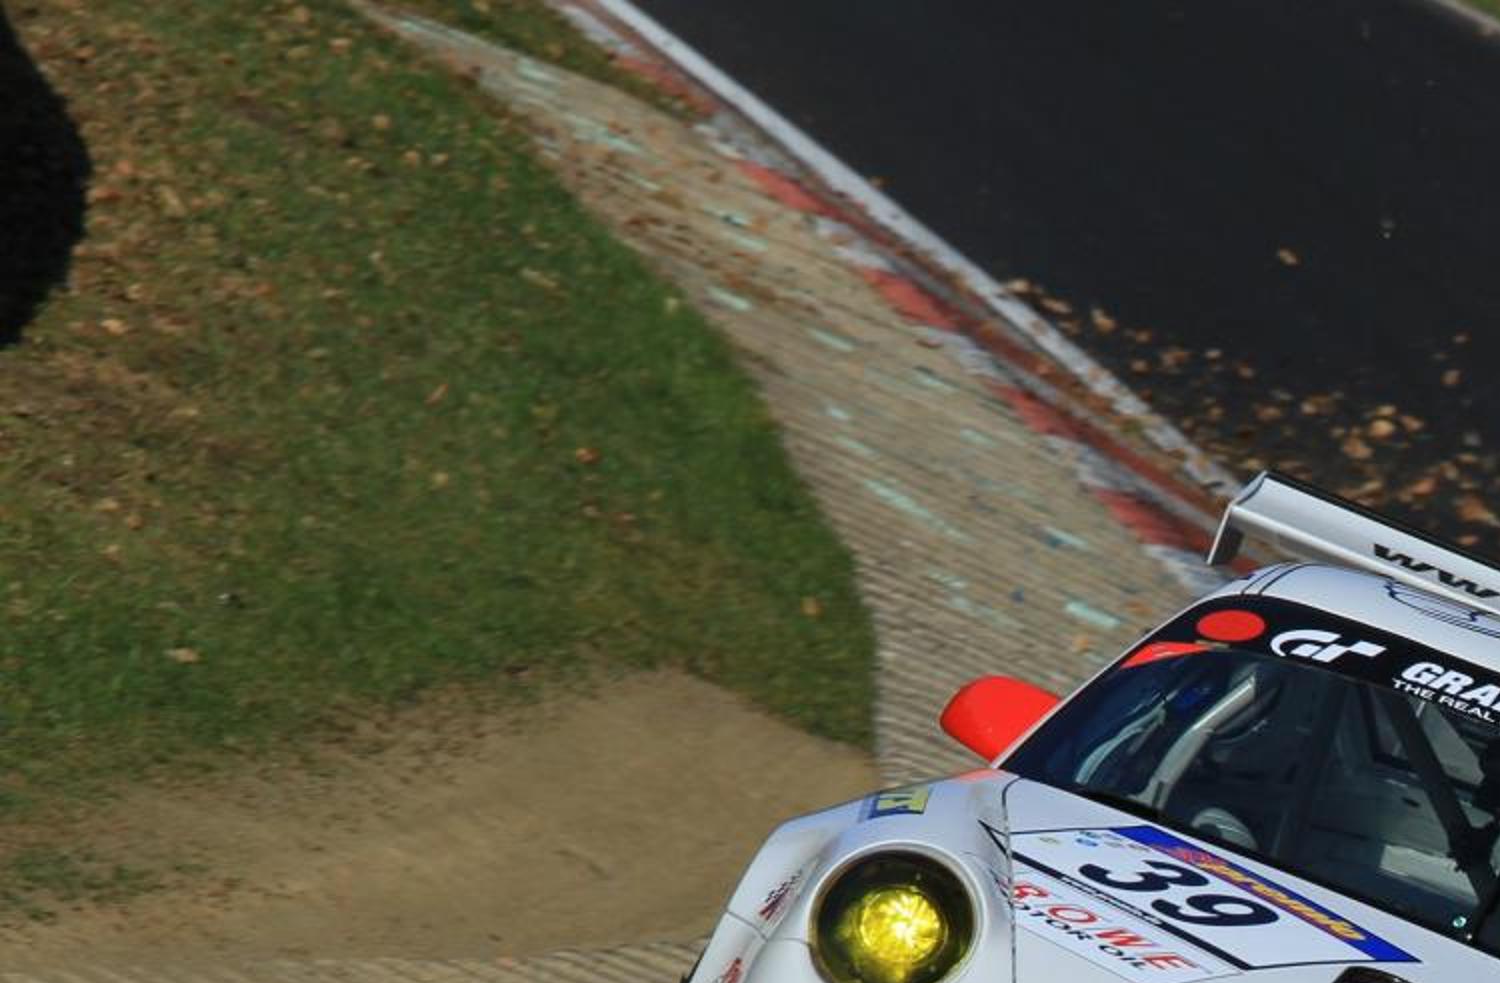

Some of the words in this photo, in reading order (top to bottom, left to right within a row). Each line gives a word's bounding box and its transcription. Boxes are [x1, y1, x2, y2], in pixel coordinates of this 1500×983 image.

[1391, 677, 1436, 701] THE
[1438, 695, 1496, 723] REAL
[1078, 859, 1280, 928] 39
